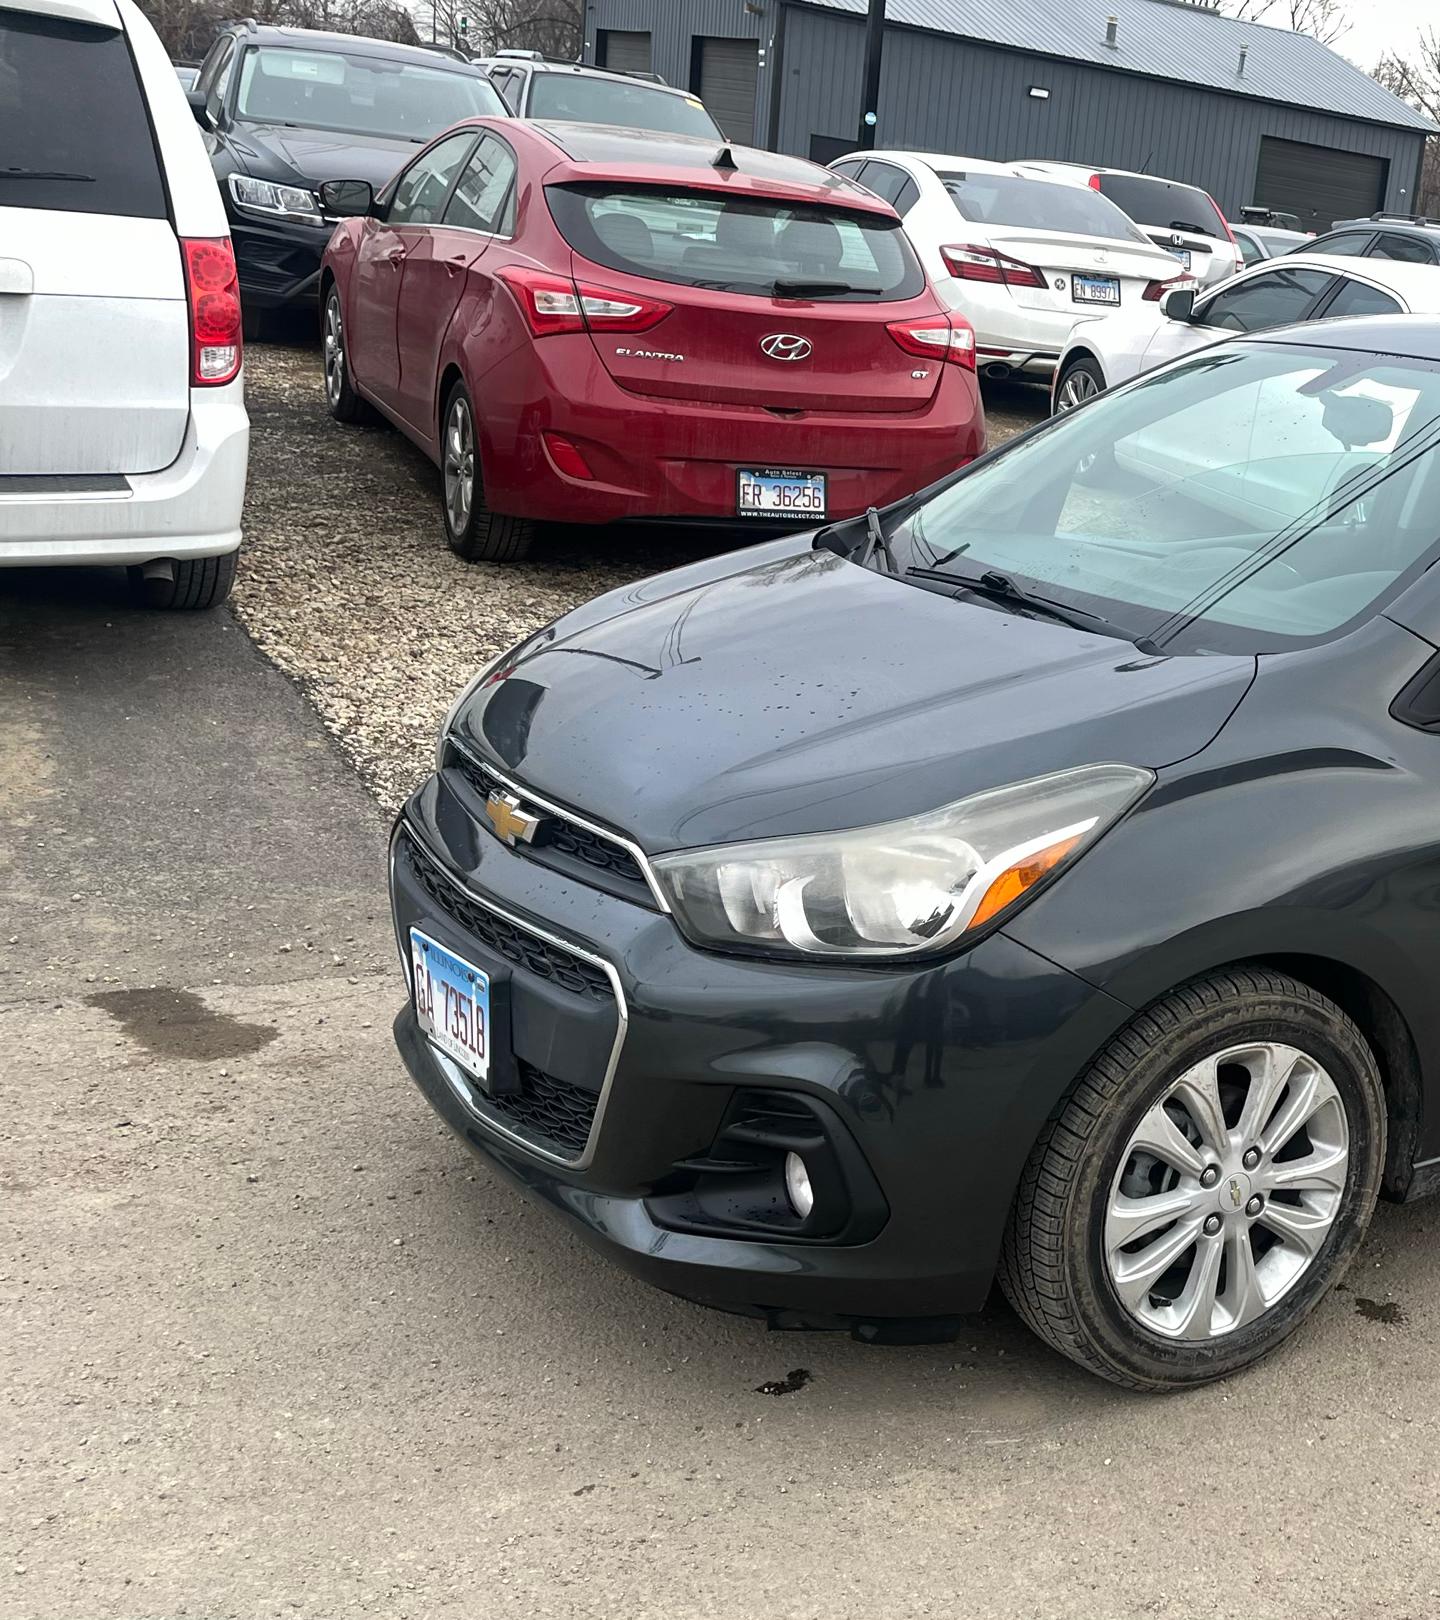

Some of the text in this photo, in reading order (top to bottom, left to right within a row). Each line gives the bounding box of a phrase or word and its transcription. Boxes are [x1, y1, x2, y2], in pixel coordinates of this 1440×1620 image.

[1090, 284, 1117, 300] 89971
[616, 348, 684, 361] ELANTRA
[912, 370, 929, 379] GT
[742, 484, 821, 509] FR 36256
[740, 511, 825, 519] WWW.THEAUTOSELECT.COM
[430, 950, 471, 983] ILLINOIS
[416, 963, 485, 1059] GA 73518
